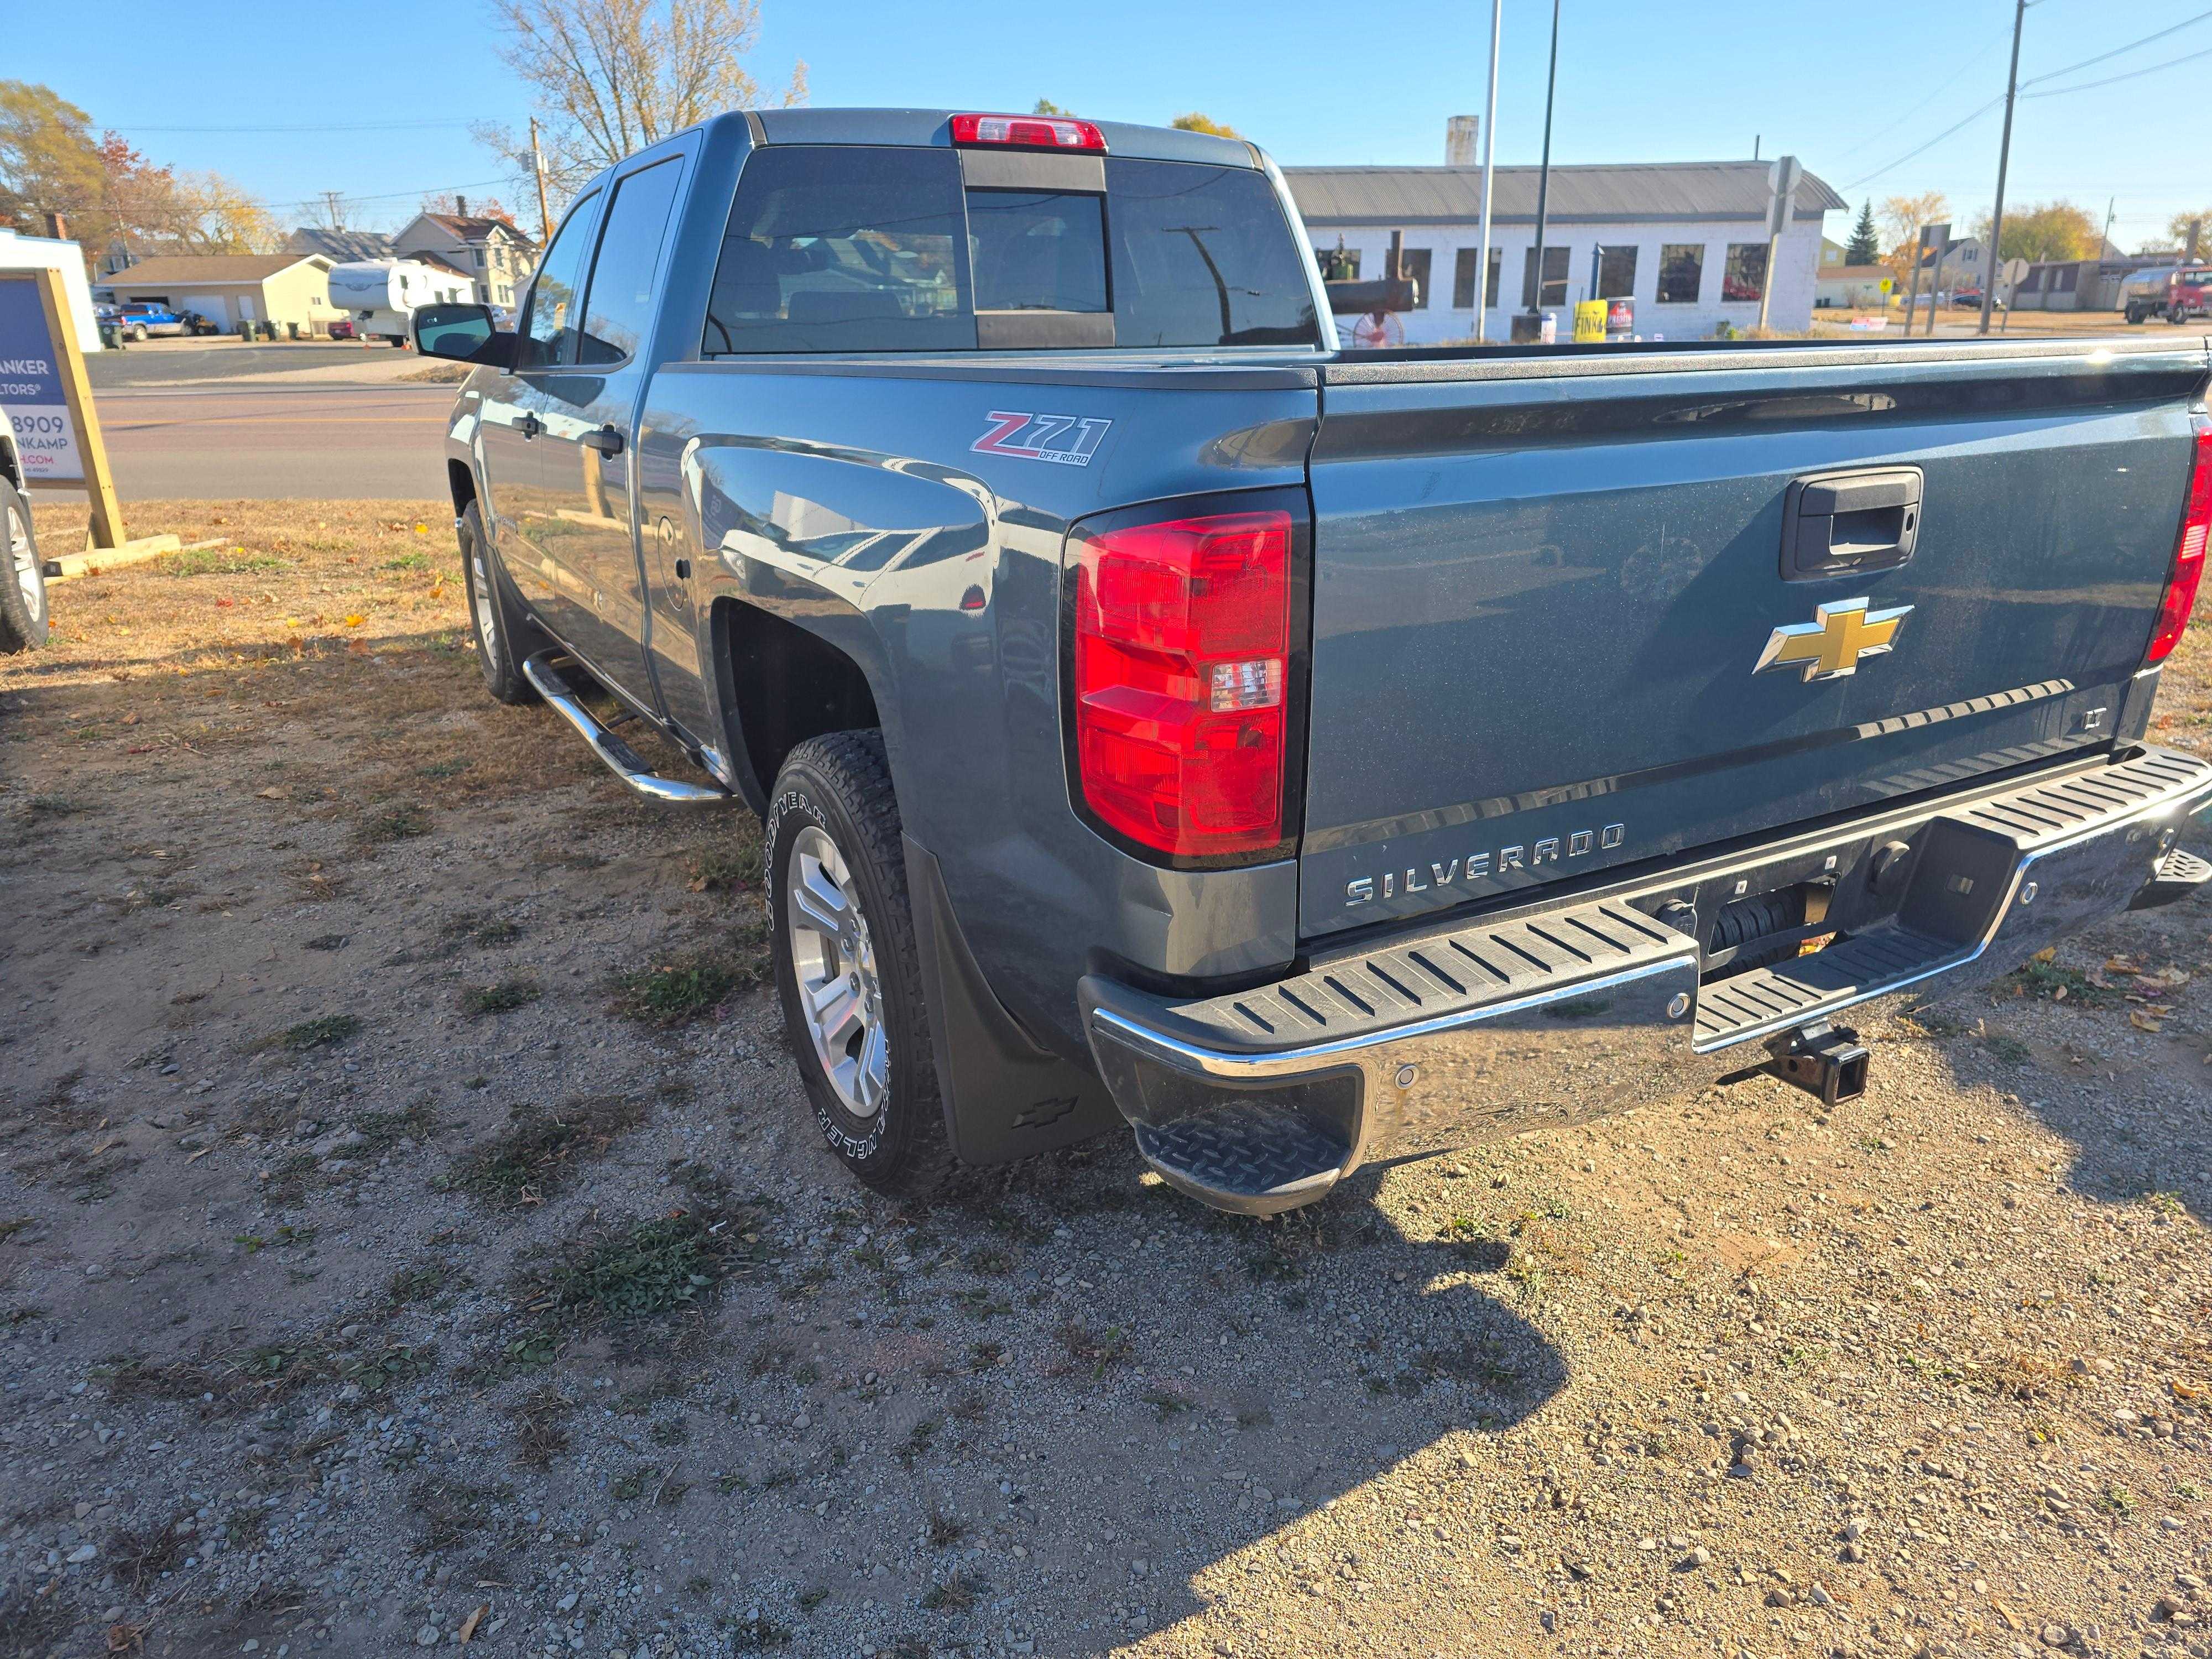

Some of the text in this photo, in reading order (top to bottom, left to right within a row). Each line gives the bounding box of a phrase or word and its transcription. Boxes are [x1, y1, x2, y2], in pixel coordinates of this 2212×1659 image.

[11, 416, 63, 433] 8909
[969, 410, 1113, 460] Z71
[1040, 451, 1089, 465] OFF ROAD
[2084, 707, 2107, 730] LT
[764, 791, 826, 932] GOODYEAR
[1344, 823, 1625, 906] SILVERADO
